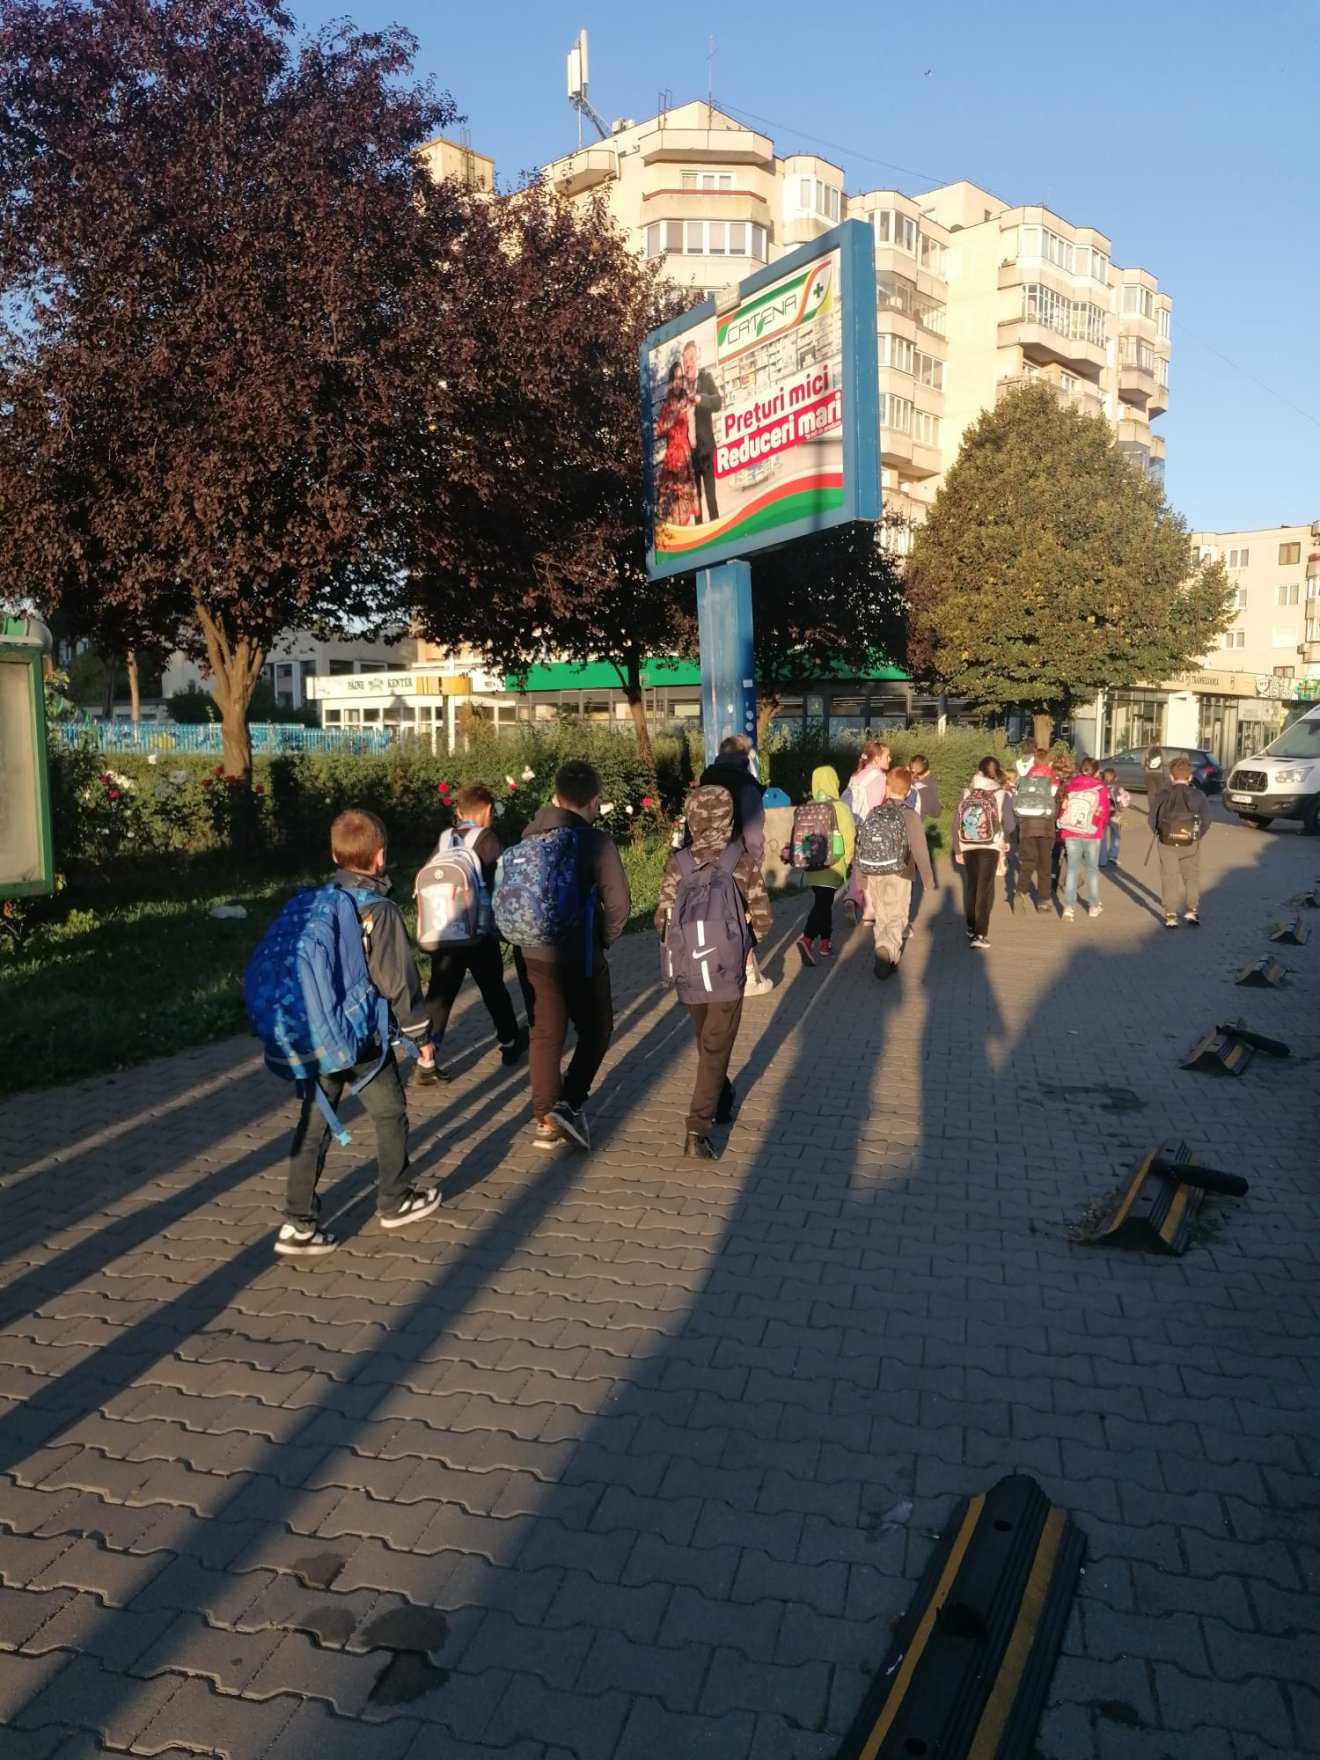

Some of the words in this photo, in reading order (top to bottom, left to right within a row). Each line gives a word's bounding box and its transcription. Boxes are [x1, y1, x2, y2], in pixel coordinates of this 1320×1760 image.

[727, 294, 797, 344] CATENA
[788, 363, 829, 408] mici
[716, 413, 796, 475] Reduceri
[798, 392, 842, 438] mari
